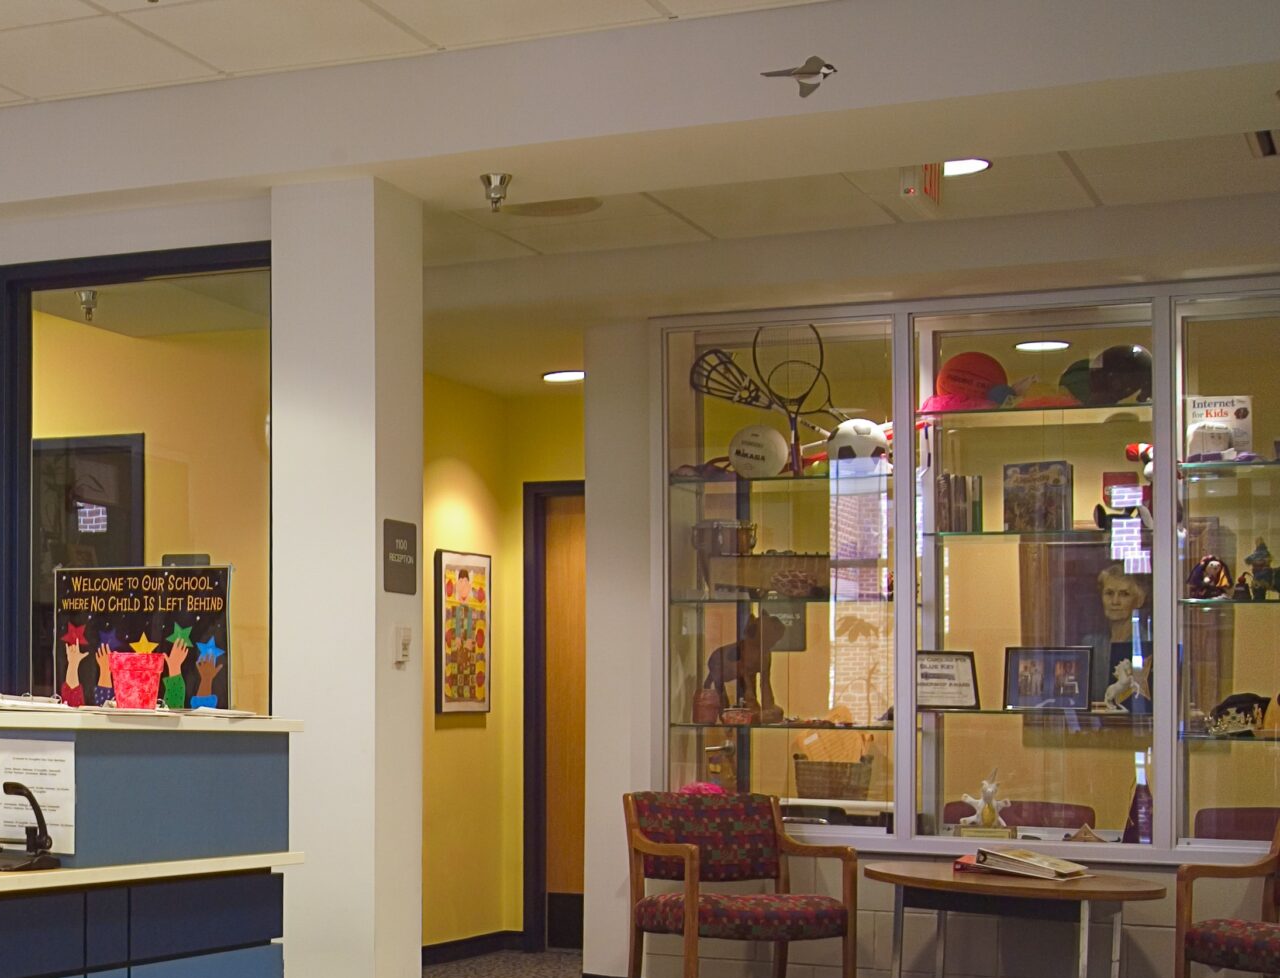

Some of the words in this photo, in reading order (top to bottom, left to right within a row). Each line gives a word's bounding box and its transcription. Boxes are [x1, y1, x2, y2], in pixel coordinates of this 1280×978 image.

[1192, 399, 1235, 409] Internet
[1205, 409, 1229, 418] Kids
[395, 539, 408, 551] 1100
[389, 552, 414, 565] RECEPTION
[72, 575, 124, 591] WELCOME
[127, 577, 139, 590] TO
[141, 575, 164, 591] OUR
[168, 574, 213, 591] SCHOOL
[62, 598, 89, 610] WHERE
[90, 596, 106, 611] NO
[108, 596, 140, 611] CHILD
[143, 596, 155, 611] IS
[158, 596, 184, 611] LEFT
[186, 596, 223, 611] BEHIND
